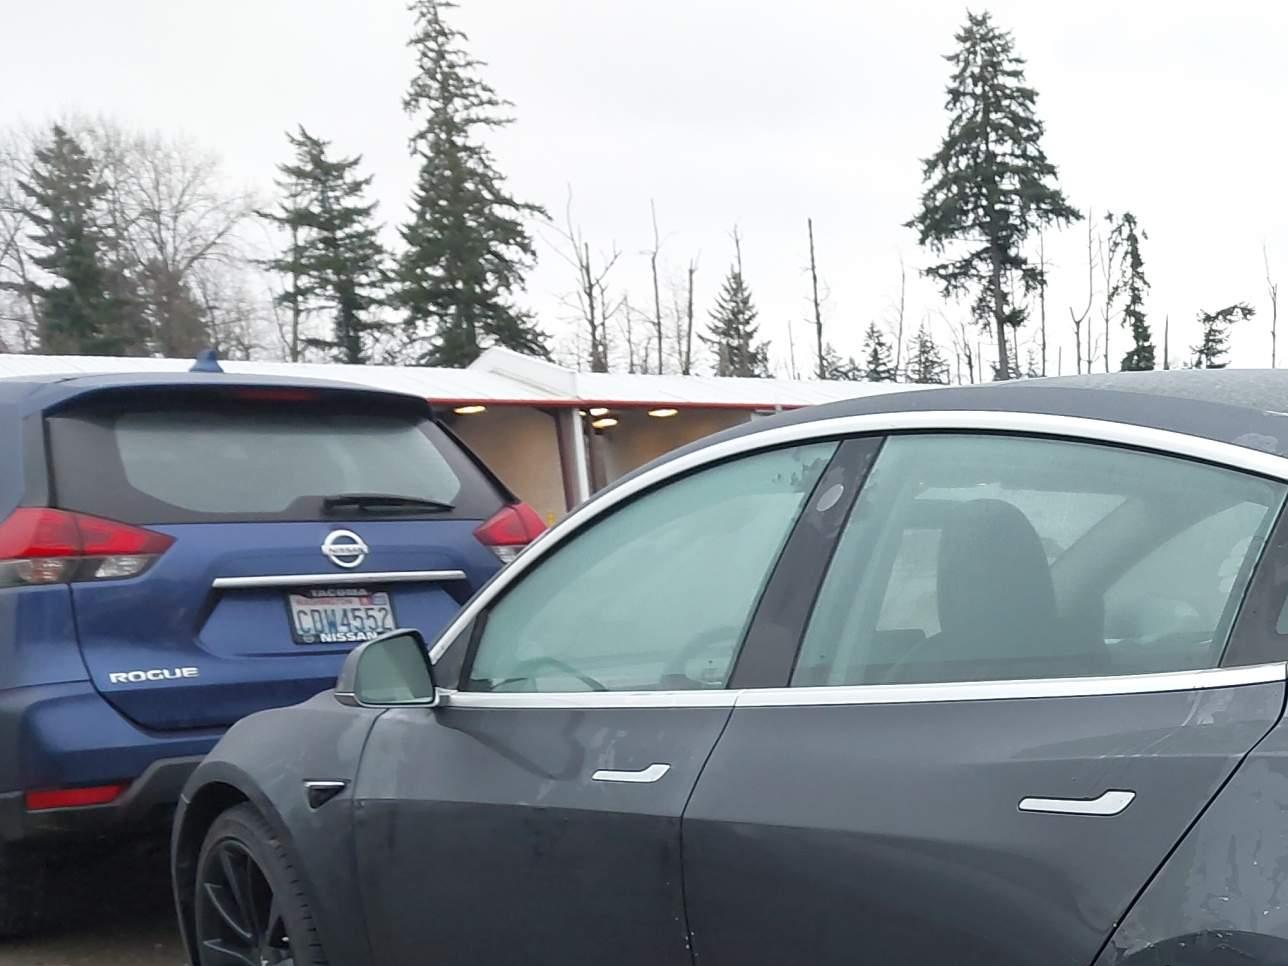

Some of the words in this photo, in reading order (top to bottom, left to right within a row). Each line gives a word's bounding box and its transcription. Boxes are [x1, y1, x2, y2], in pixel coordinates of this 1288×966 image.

[297, 607, 392, 634] CDW4552
[320, 631, 378, 643] NISSAN
[109, 667, 200, 683] ROGUE
